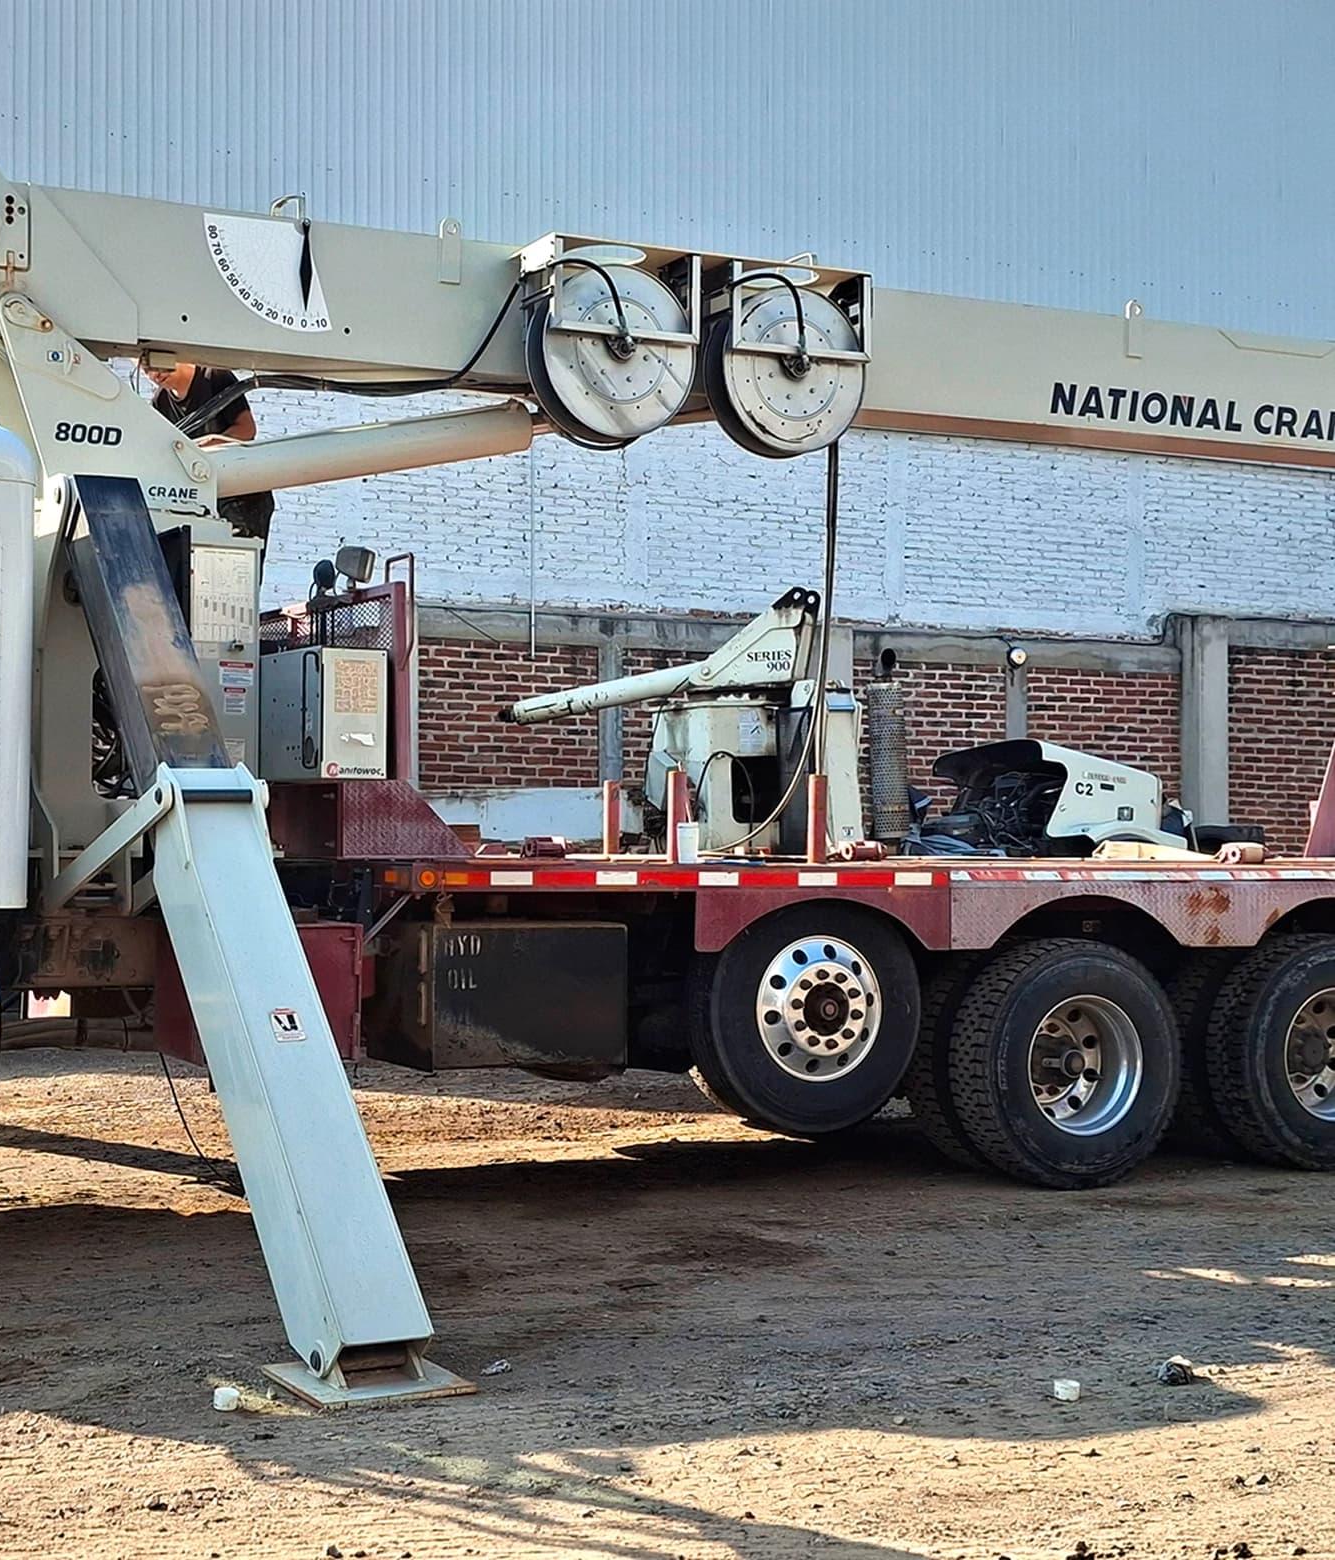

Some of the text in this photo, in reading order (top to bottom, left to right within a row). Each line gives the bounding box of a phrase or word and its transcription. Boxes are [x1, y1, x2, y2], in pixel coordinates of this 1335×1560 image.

[207, 224, 218, 239] 80
[212, 242, 223, 256] 70
[217, 258, 230, 272] 60
[226, 272, 239, 288] 50
[238, 287, 251, 301] 40
[250, 299, 264, 312] 30
[264, 308, 279, 321] 20
[282, 315, 294, 326] 10
[300, 318, 308, 328] 0
[1050, 382, 1242, 432] NATIONAL
[54, 422, 123, 446] 800D
[148, 486, 199, 499] CRANE
[746, 650, 793, 662] SERIES
[766, 661, 791, 673] 900
[1075, 782, 1094, 796] C2
[447, 968, 478, 989] OIL
